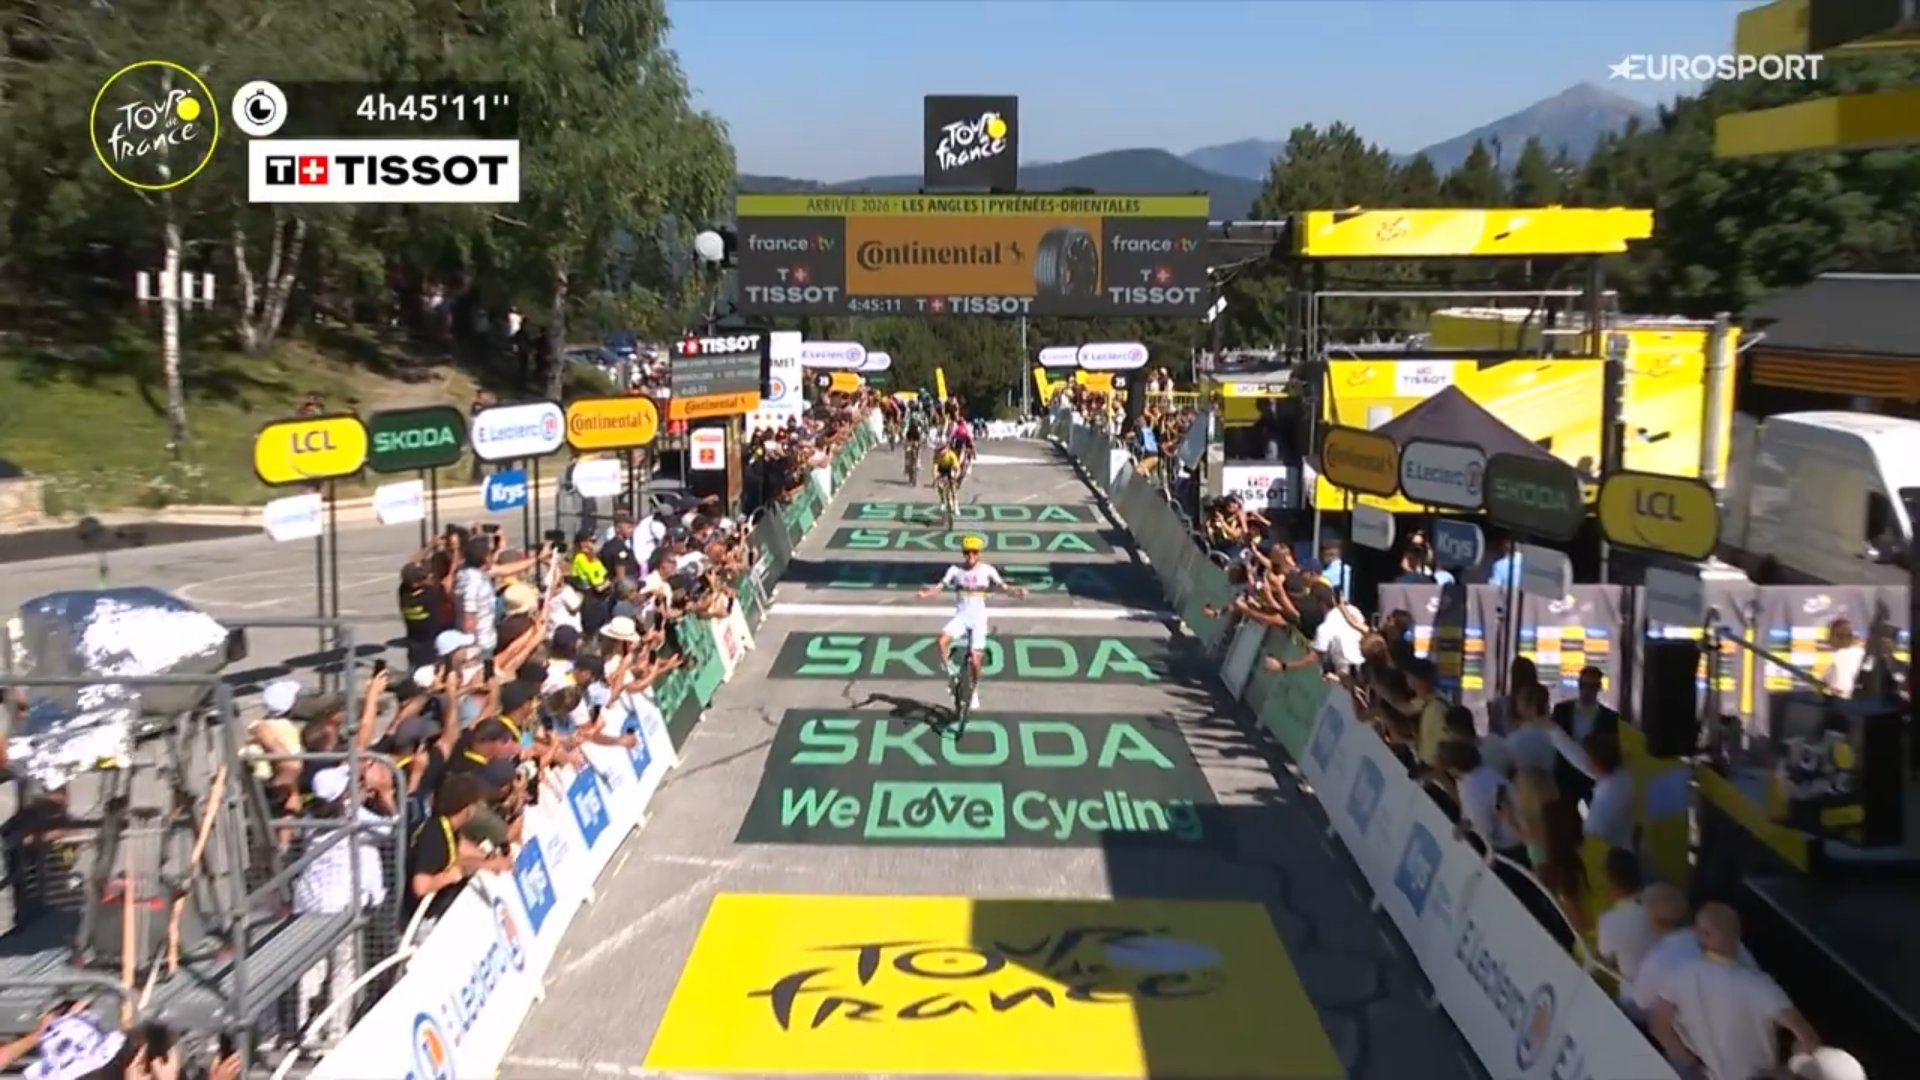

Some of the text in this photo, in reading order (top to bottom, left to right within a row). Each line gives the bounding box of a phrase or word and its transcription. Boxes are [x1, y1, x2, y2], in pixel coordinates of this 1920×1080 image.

[861, 200, 890, 213] 2026
[902, 200, 924, 213] LES
[927, 200, 979, 213] ANGLES
[856, 240, 1002, 272] Continental
[745, 285, 840, 303] TISSOT
[848, 298, 901, 313] 4:45:11
[948, 297, 1034, 313] TISSOT
[1108, 286, 1201, 304] TISSOT
[699, 334, 761, 354] TISSOT
[570, 411, 642, 436] Continental
[291, 430, 337, 454] LCL
[373, 425, 456, 452] SKODA
[490, 482, 526, 504] Krys
[1634, 488, 1685, 523] LCL
[1436, 530, 1473, 560] Krys
[790, 718, 1176, 769] SKODA
[780, 786, 860, 828] We
[1012, 789, 1202, 840] Cycling
